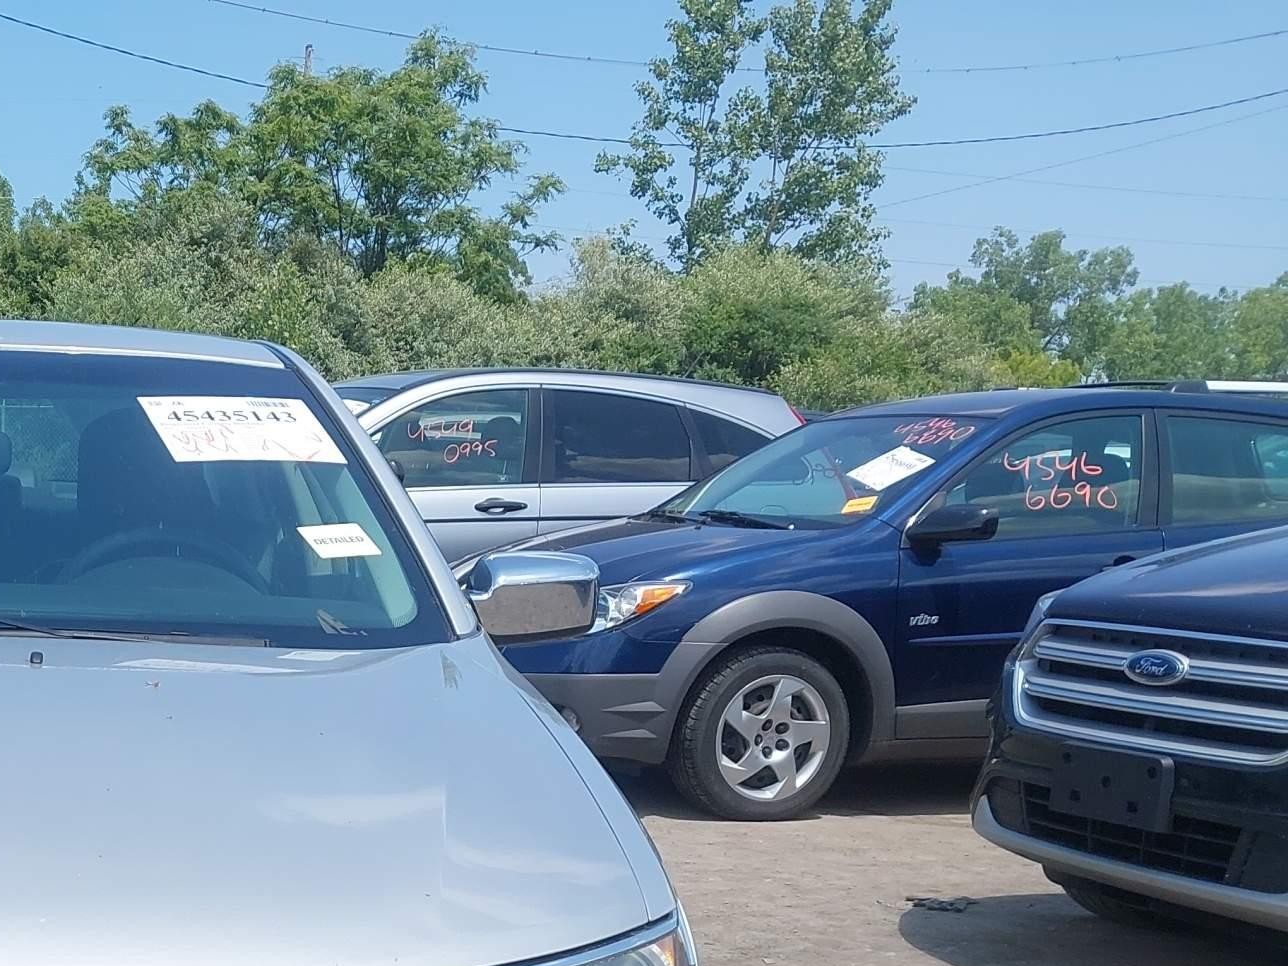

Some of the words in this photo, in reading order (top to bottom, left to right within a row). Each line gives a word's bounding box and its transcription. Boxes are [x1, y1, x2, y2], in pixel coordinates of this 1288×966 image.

[167, 410, 297, 423] 45435143
[407, 419, 474, 442] 4549
[443, 439, 498, 463] 0995
[1003, 451, 1103, 481] 4546
[1025, 481, 1118, 510] 6690
[313, 535, 365, 546] DETAILED
[1135, 657, 1169, 676] Ford
